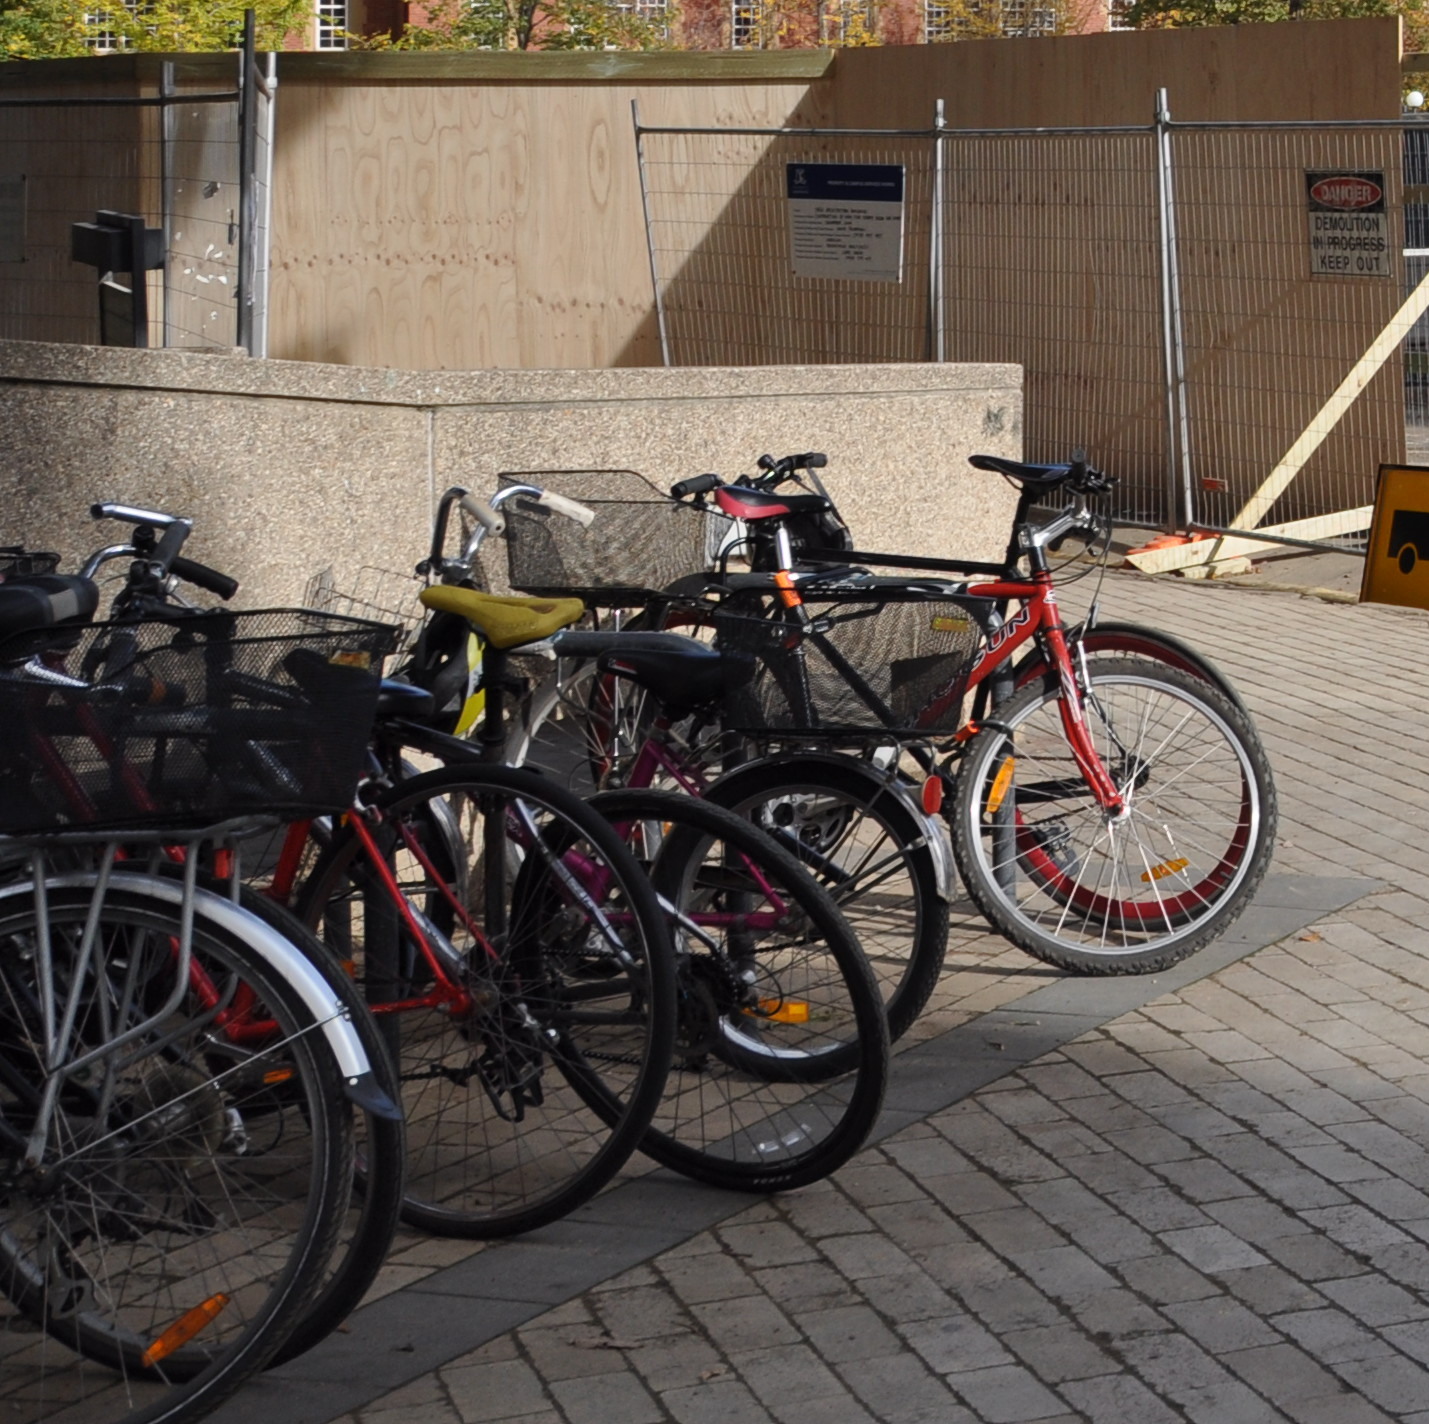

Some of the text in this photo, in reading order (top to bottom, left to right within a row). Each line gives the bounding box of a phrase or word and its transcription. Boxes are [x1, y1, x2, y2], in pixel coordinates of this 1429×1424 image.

[1321, 185, 1372, 202] DANGER
[1315, 216, 1380, 232] DEMOLITION
[1312, 236, 1386, 252] IN PROGRESS
[1320, 255, 1381, 271] KEEP OUT
